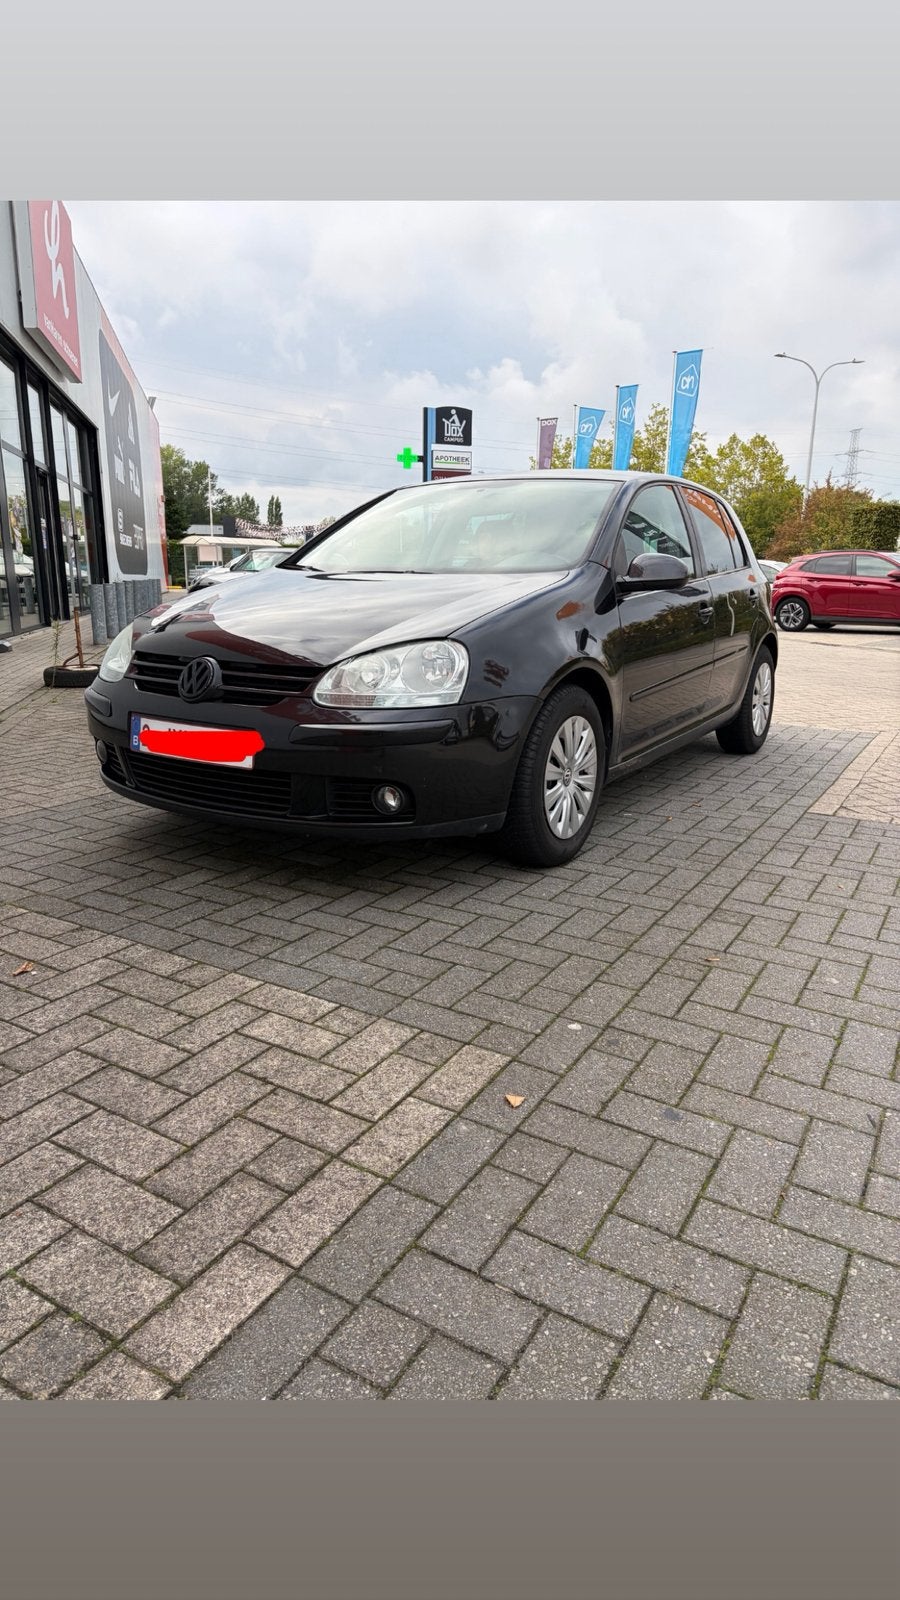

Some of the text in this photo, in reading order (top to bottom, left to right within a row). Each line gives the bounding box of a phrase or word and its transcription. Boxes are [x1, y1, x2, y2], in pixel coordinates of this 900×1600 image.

[541, 419, 557, 427] DOX
[434, 455, 470, 463] APOTHEEK
[132, 735, 139, 746] B
